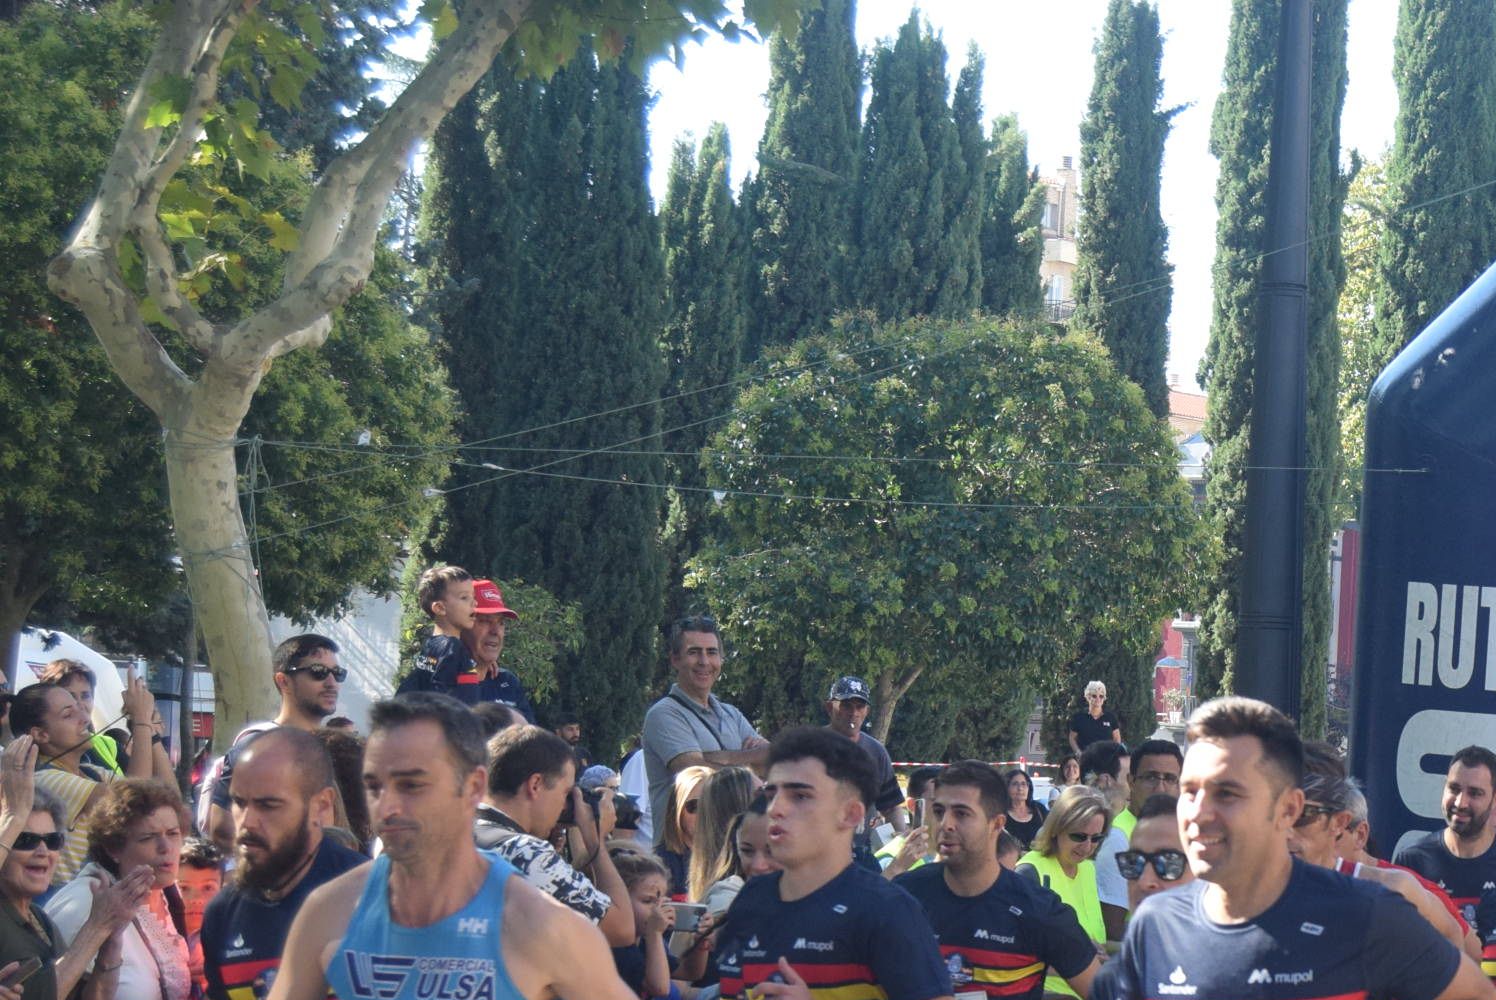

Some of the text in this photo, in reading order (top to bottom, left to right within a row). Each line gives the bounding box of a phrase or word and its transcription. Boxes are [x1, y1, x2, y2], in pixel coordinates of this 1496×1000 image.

[458, 917, 489, 934] HH
[417, 956, 497, 972] COMERCIAL
[1275, 970, 1313, 986] mupol
